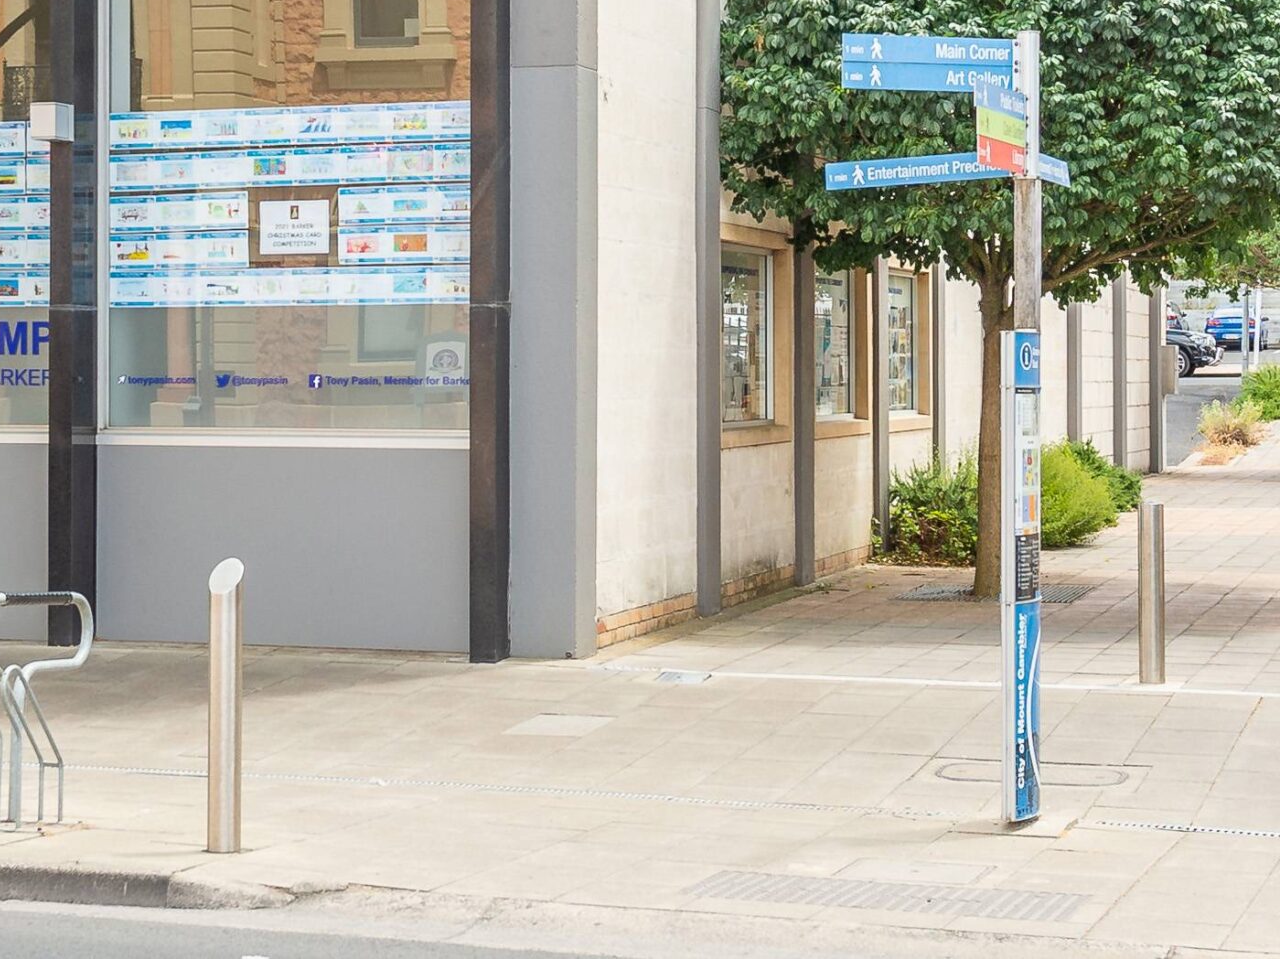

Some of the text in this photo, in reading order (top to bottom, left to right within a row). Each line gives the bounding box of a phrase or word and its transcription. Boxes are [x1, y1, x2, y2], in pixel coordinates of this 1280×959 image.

[851, 45, 864, 54] min
[935, 42, 966, 59] Main
[969, 43, 1010, 60] Corner
[946, 71, 965, 86] Art
[867, 160, 949, 181] Entertainment
[128, 375, 197, 386] tonypasin.com
[231, 375, 289, 387] @tonypasin
[326, 375, 349, 387] Tony
[351, 375, 381, 387] Pasin,
[383, 375, 423, 386] Member
[426, 374, 439, 386] for
[1017, 613, 1026, 789] City of Mount Gambier
